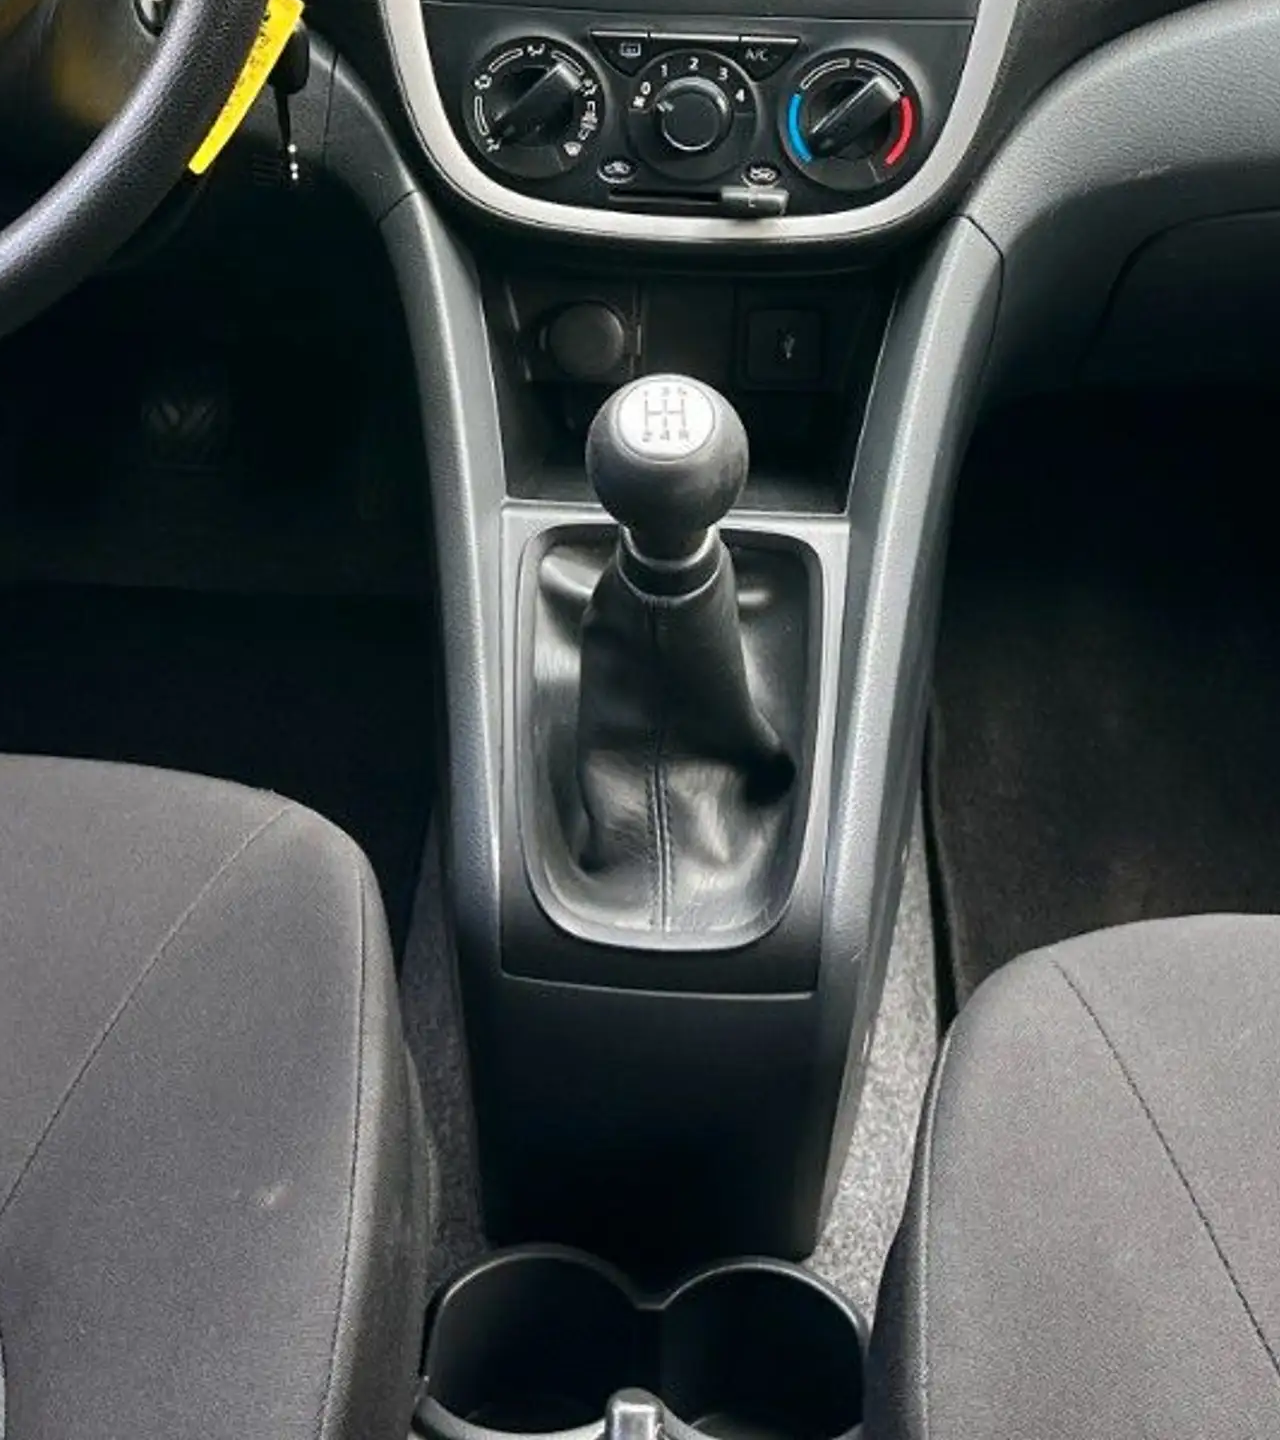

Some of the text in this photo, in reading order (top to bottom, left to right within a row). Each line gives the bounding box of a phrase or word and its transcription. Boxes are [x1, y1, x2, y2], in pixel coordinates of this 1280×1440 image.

[744, 47, 769, 62] A/C
[660, 63, 668, 78] 1
[688, 56, 699, 71] 2
[719, 66, 729, 81] 3
[640, 81, 652, 96] 0
[735, 88, 745, 103] 4
